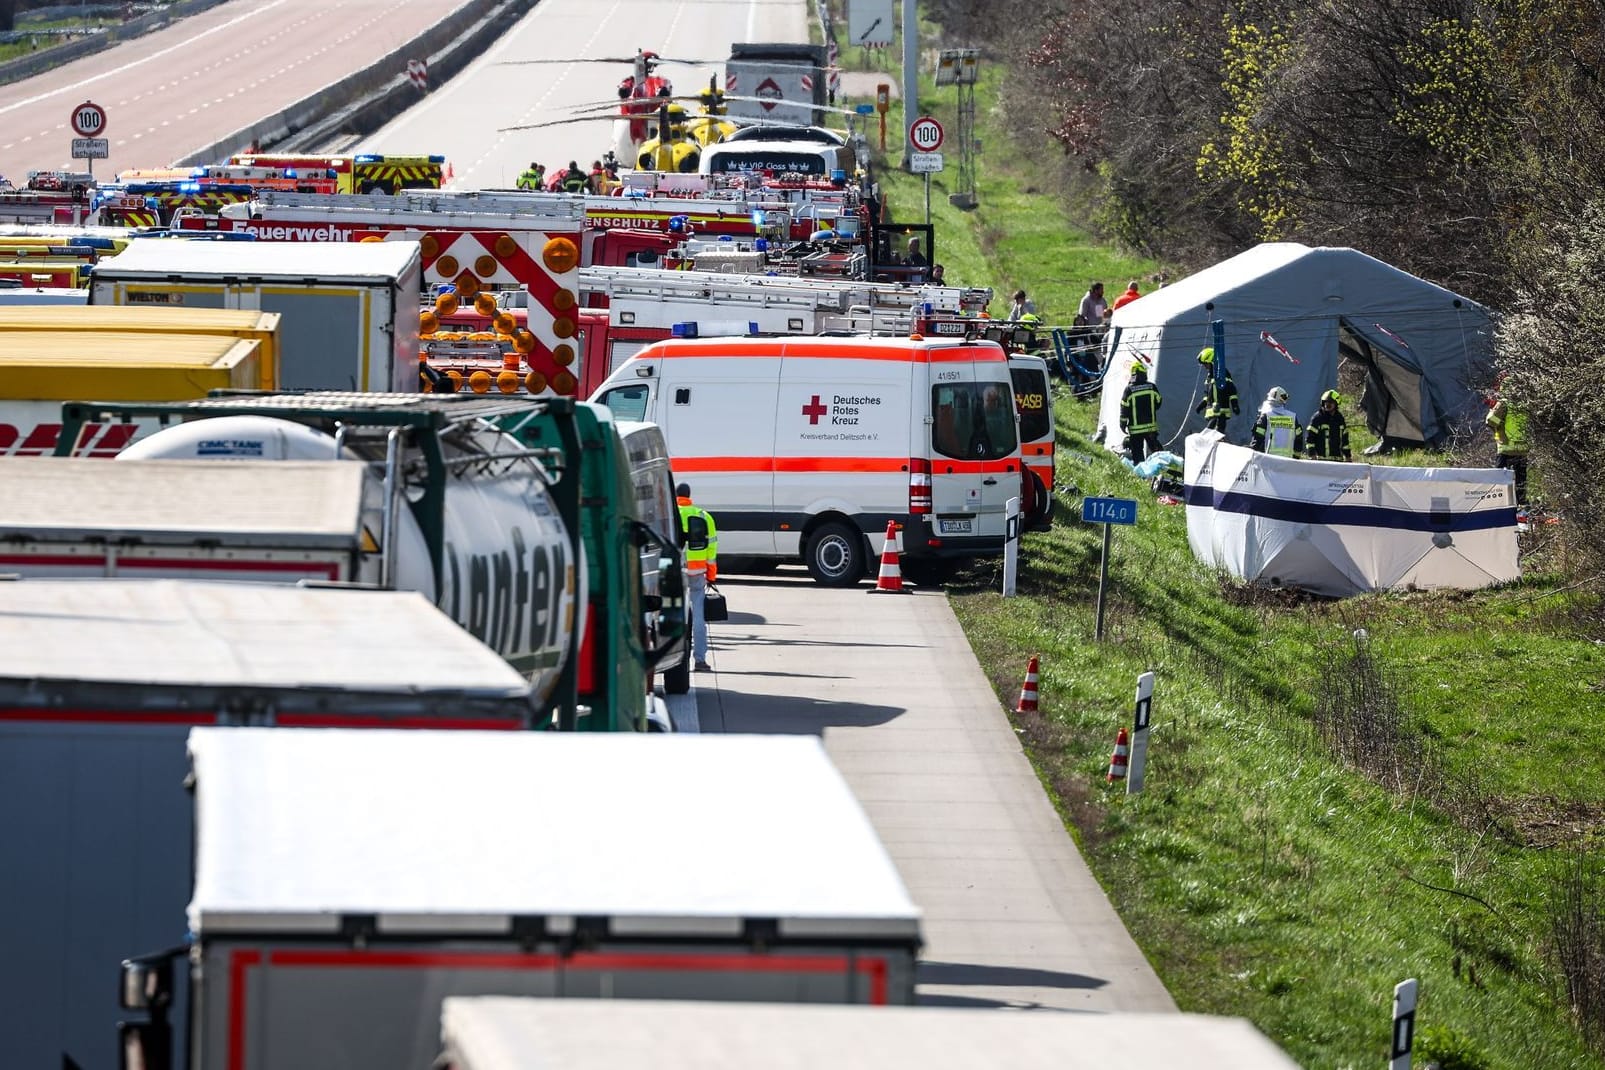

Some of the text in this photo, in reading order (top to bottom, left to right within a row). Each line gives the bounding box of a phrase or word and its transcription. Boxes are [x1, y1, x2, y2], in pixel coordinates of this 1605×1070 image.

[79, 112, 99, 128] 100
[917, 127, 937, 142] 100
[766, 162, 786, 170] Class
[232, 221, 353, 242] Feuerwehr
[127, 292, 169, 303] WIELTON
[833, 394, 881, 405] Deutsches
[1023, 393, 1042, 409] ASB
[832, 406, 860, 415] Rotes
[831, 415, 860, 425] Kreuz
